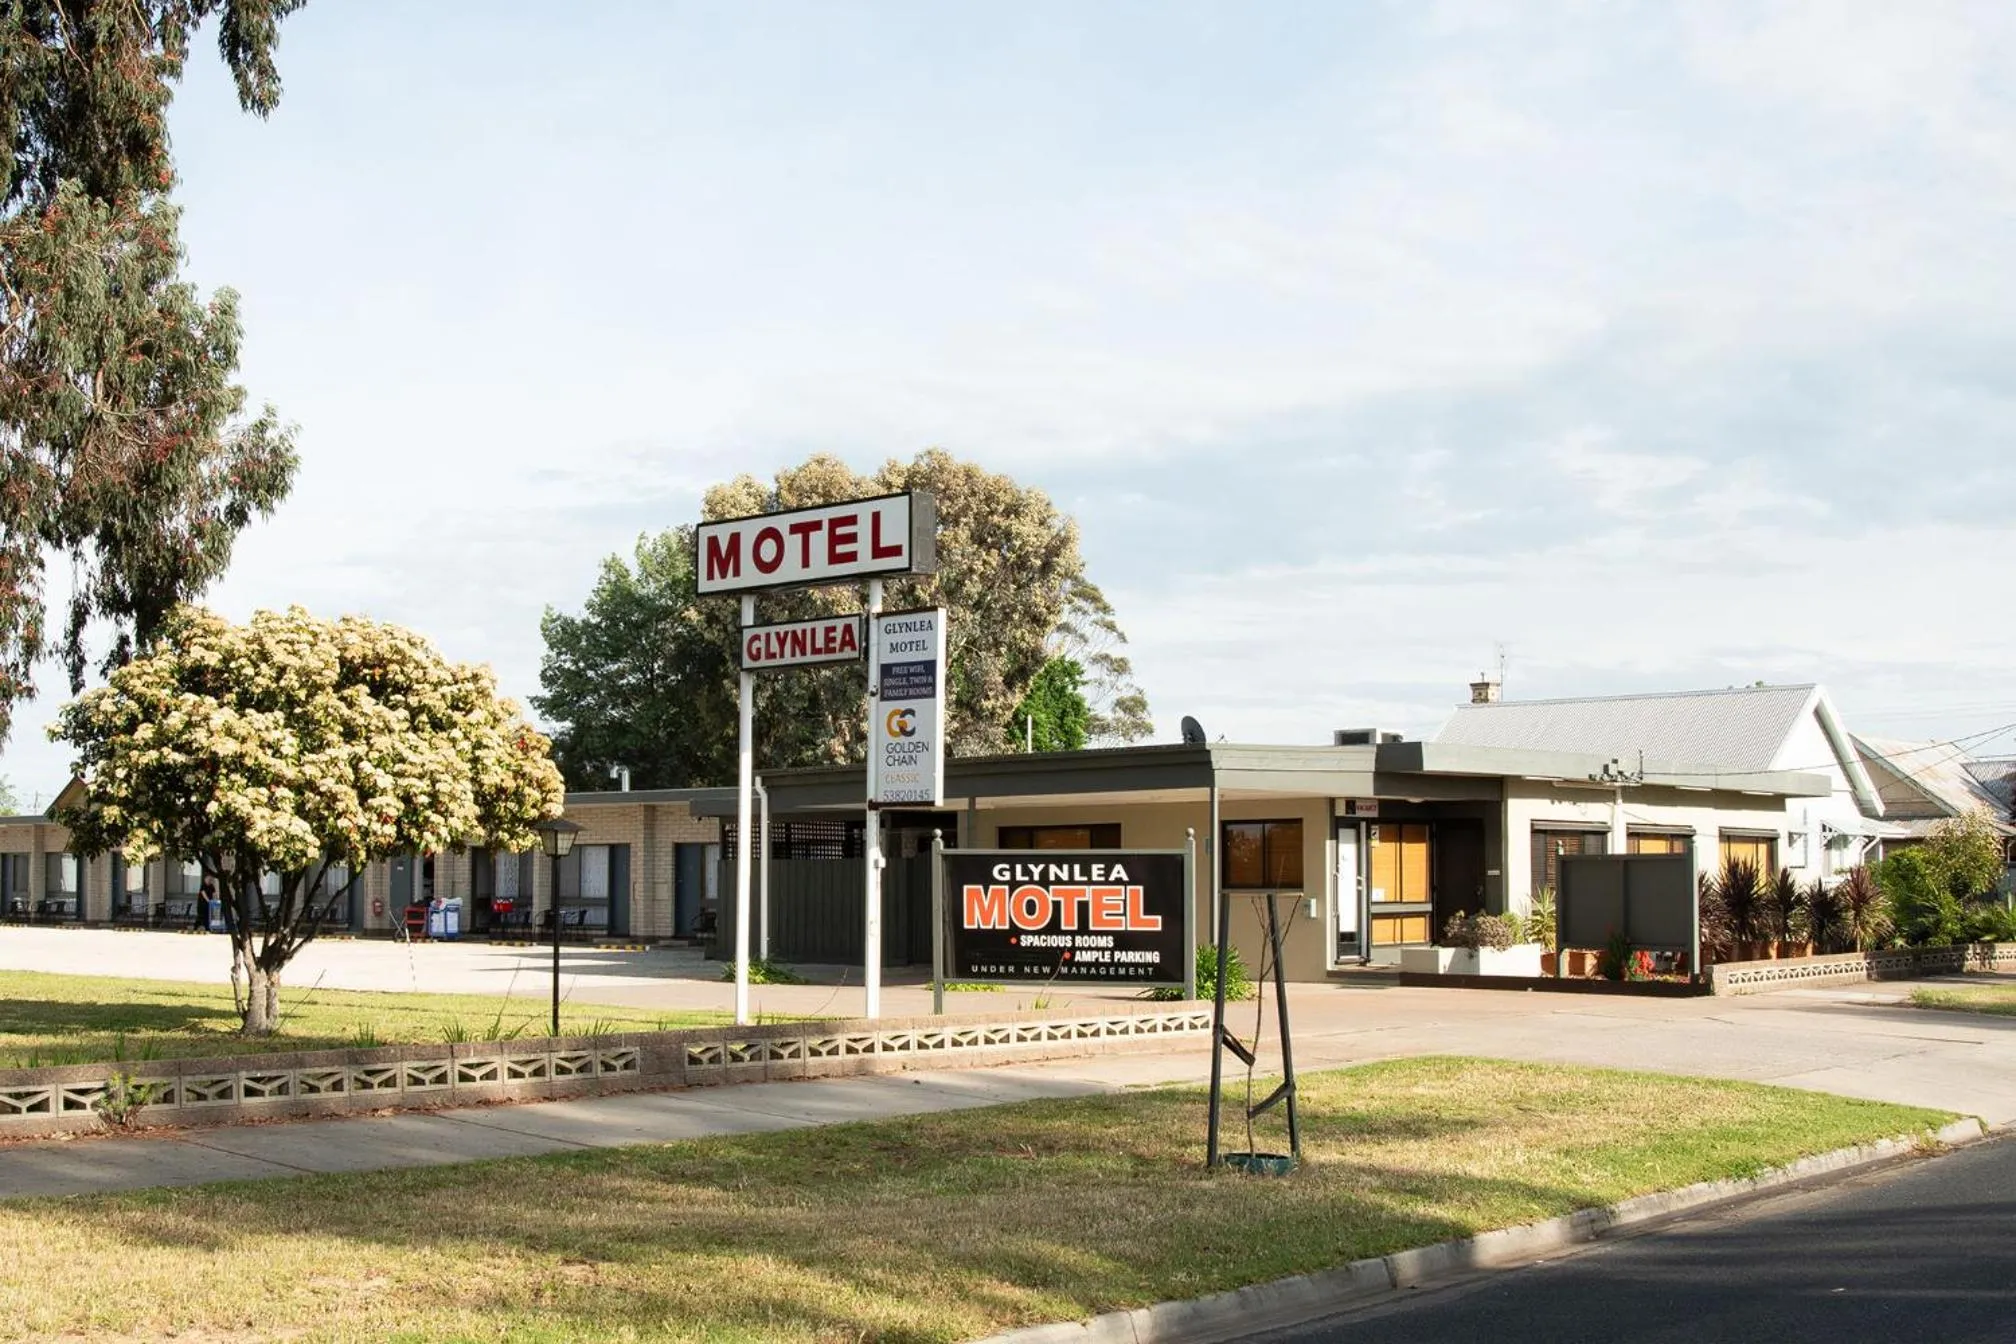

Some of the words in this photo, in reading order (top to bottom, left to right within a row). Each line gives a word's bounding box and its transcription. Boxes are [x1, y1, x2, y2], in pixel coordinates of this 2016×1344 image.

[706, 510, 903, 581] MOTEL
[884, 620, 933, 634] GLYNLEA
[747, 623, 857, 662] GLYNLEA
[889, 640, 928, 653] MOTEL
[886, 741, 929, 754] GOLDEN
[886, 754, 917, 766] CHAIN
[886, 772, 919, 784] CLASSIC
[992, 863, 1129, 881] GLYNLEA
[963, 884, 1162, 931] MOTEL
[1020, 935, 1072, 947] SPACIOUS
[1075, 936, 1114, 947] ROOMS
[1074, 950, 1111, 963] AMPLE
[1115, 951, 1160, 963] PARKING
[971, 965, 1015, 973] UNDER
[1024, 966, 1051, 974] NEW
[1058, 966, 1155, 976] MANAGEMENT
